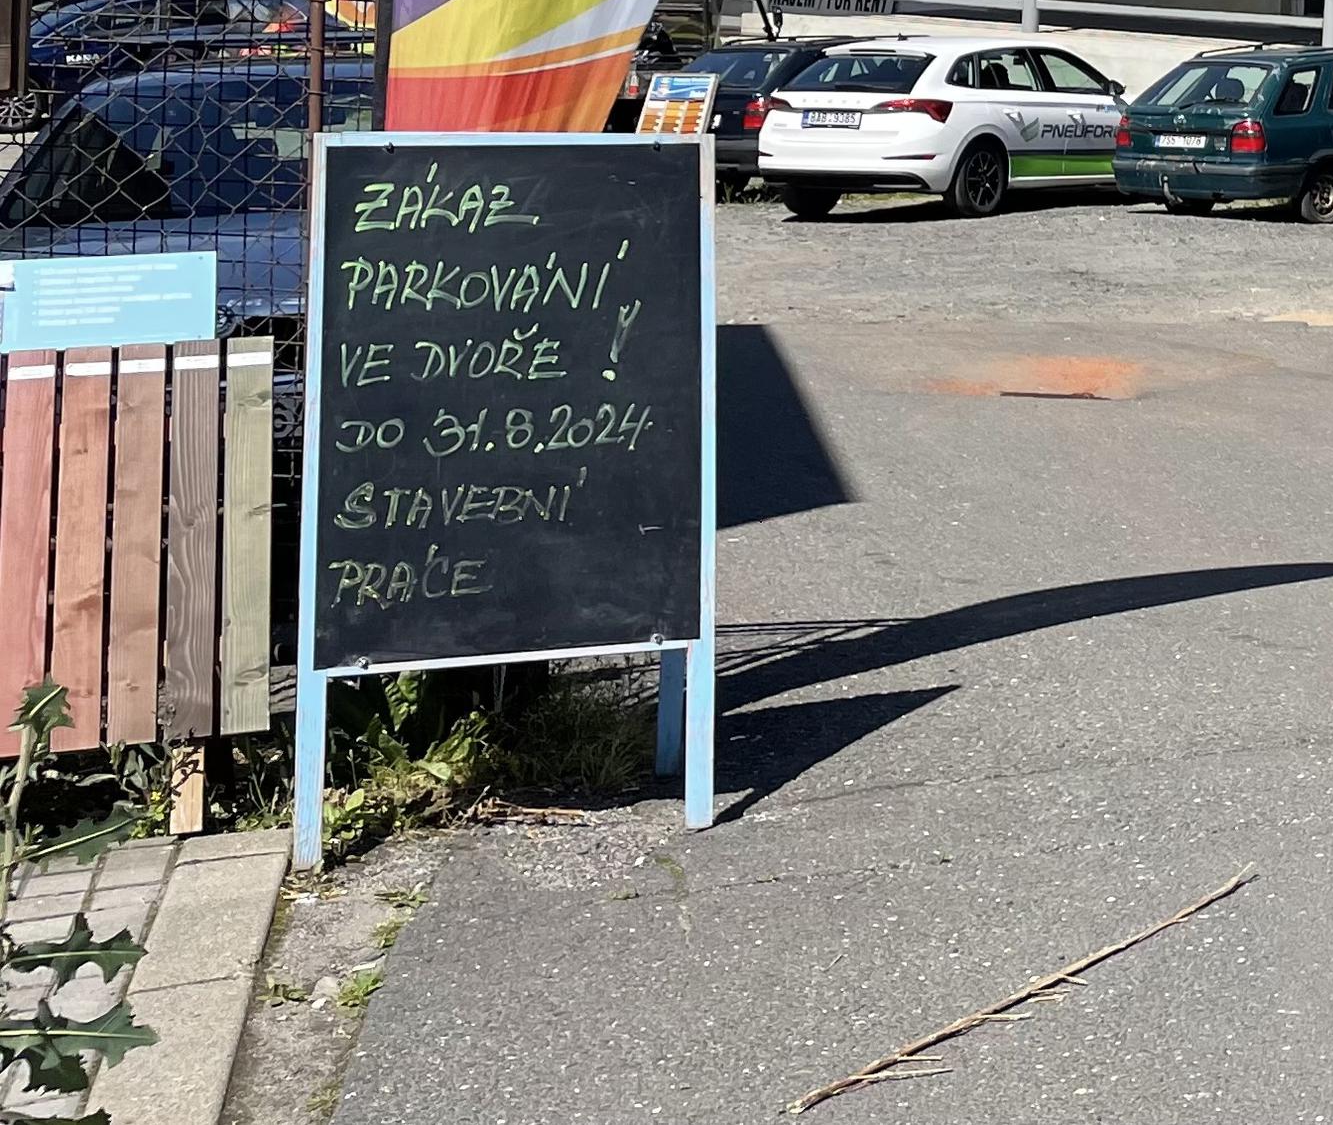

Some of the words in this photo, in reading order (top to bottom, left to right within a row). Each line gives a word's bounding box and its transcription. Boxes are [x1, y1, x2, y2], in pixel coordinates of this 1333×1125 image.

[340, 238, 631, 313] PARKOVÁNÍ
[339, 342, 394, 387] VE
[410, 323, 568, 380] DVOŘE
[335, 418, 405, 453] DO
[334, 466, 589, 530] STAVEBNÍ
